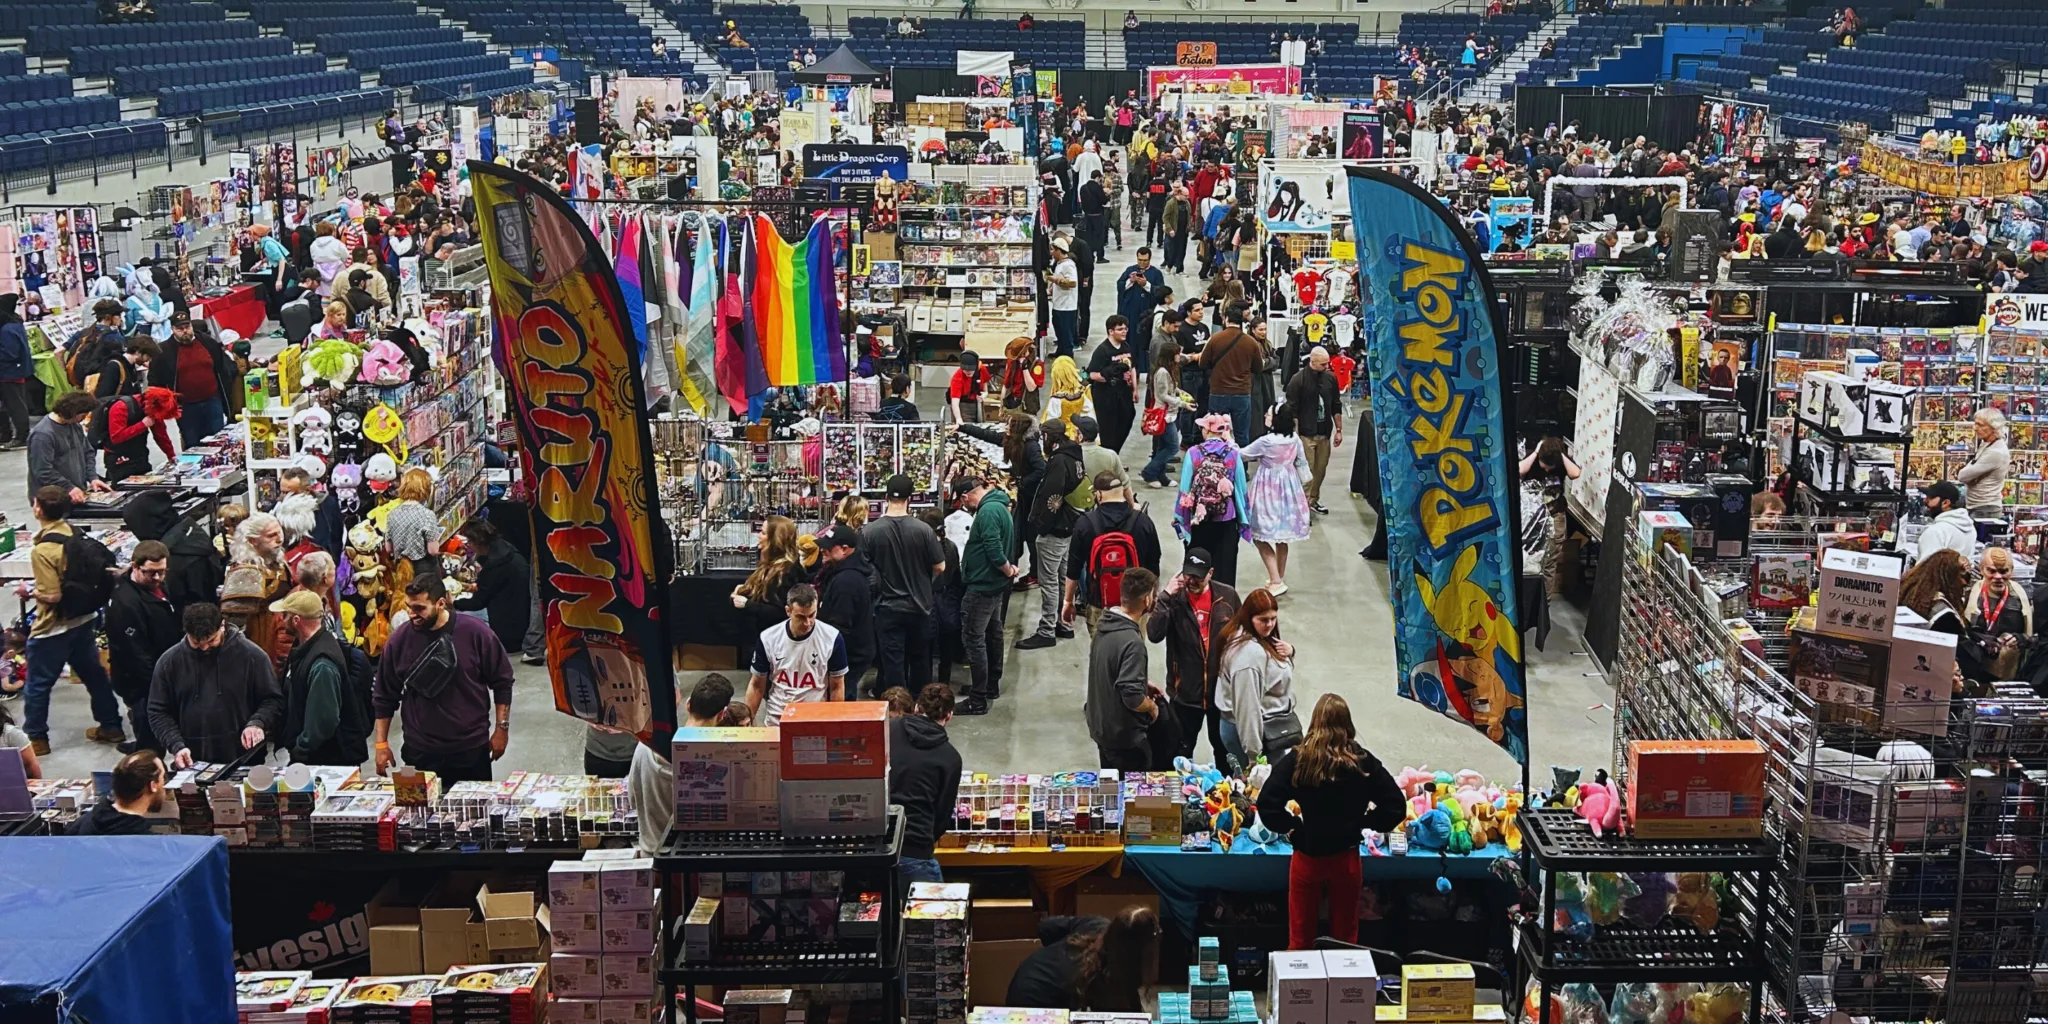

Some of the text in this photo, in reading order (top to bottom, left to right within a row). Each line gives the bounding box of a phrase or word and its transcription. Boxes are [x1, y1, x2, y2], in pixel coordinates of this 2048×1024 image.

[1180, 53, 1213, 64] Fiction
[812, 150, 899, 164] Little Dragon Corp
[519, 304, 624, 635] NARUTO
[1834, 576, 1884, 594] DIORAMATIC
[777, 670, 816, 688] AIA
